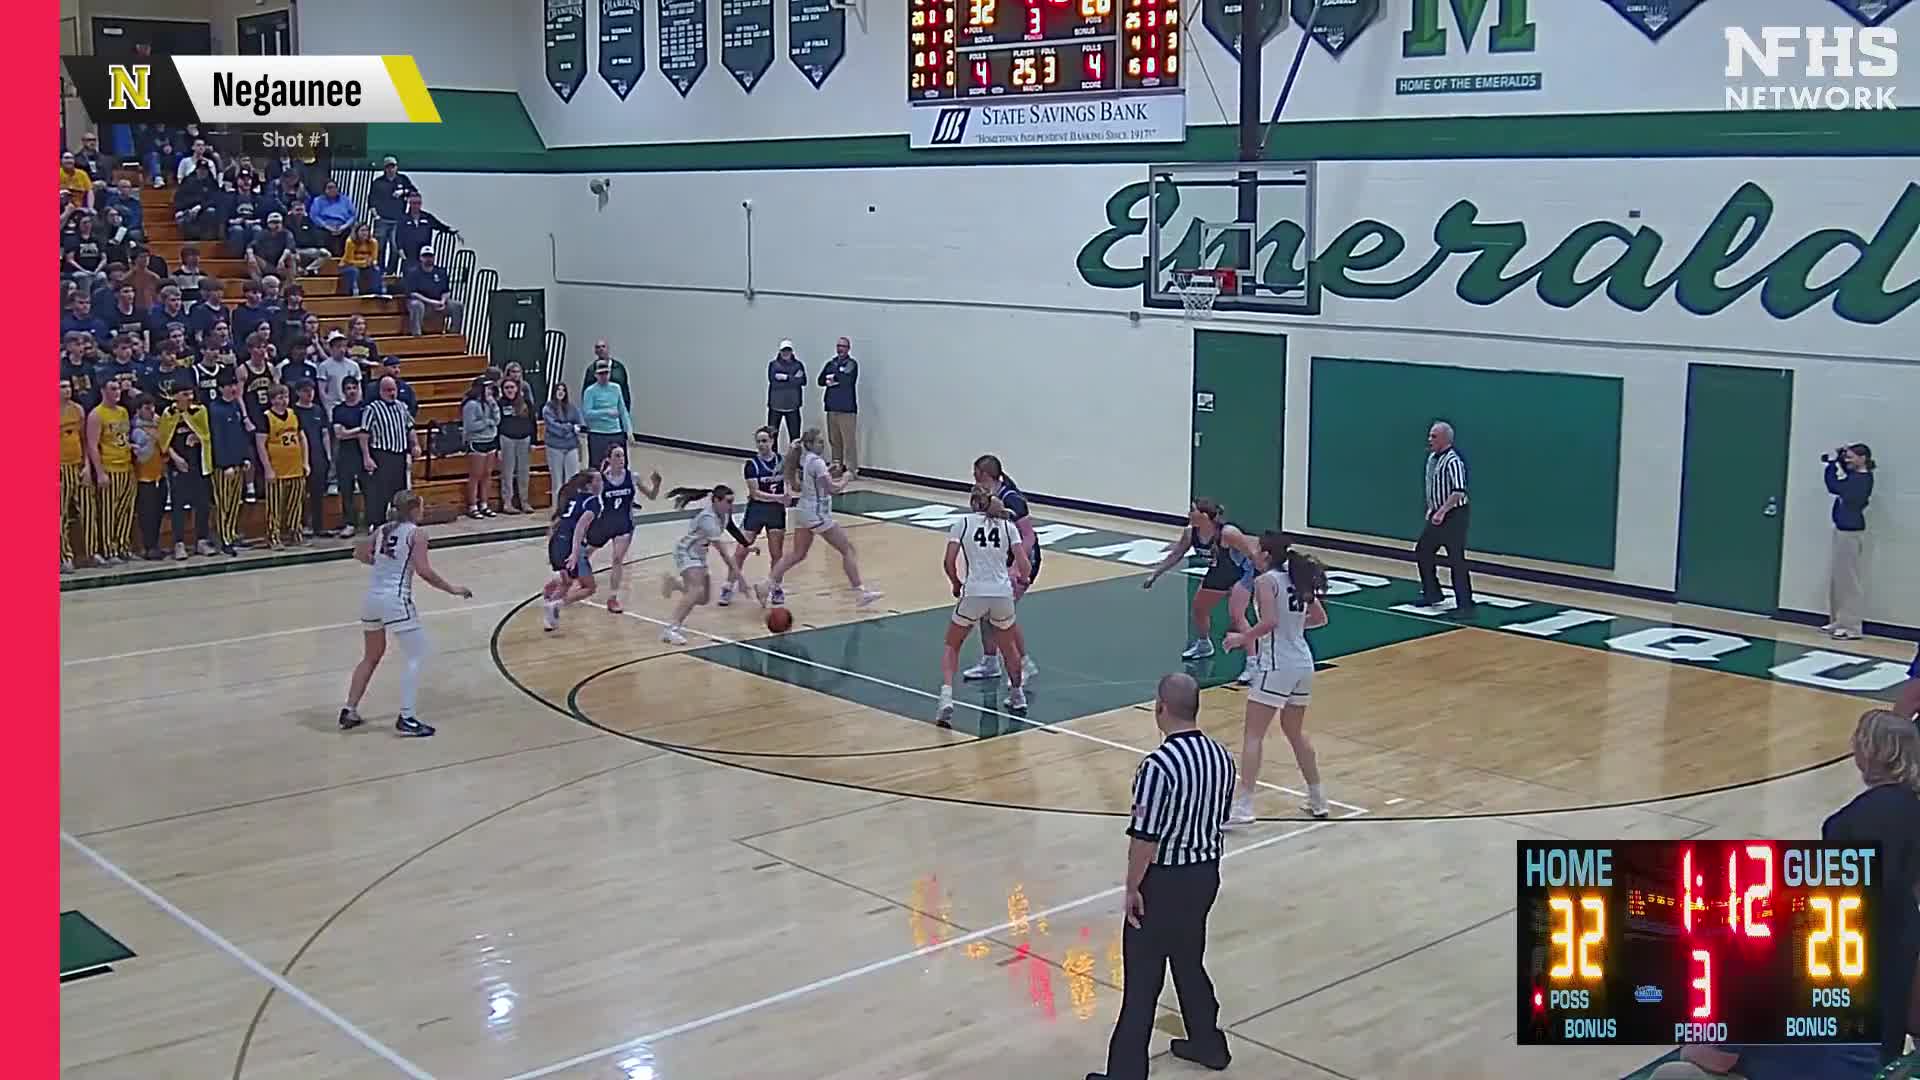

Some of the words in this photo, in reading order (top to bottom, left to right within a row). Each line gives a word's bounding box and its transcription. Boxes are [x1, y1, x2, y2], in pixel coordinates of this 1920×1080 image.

[1030, 8, 1040, 34] 3
[976, 61, 988, 85] 4
[1013, 57, 1037, 85] 25
[1043, 56, 1055, 83] 3
[1089, 53, 1101, 79] 4
[1400, 79, 1431, 92] HOME
[1433, 78, 1448, 90] OF
[1450, 77, 1471, 89] THE
[1475, 75, 1537, 88] EMERALDS
[982, 106, 1026, 126] STATE
[1030, 104, 1096, 125] SAVINGS
[1100, 101, 1149, 121] BANK
[973, 526, 1001, 548] 44
